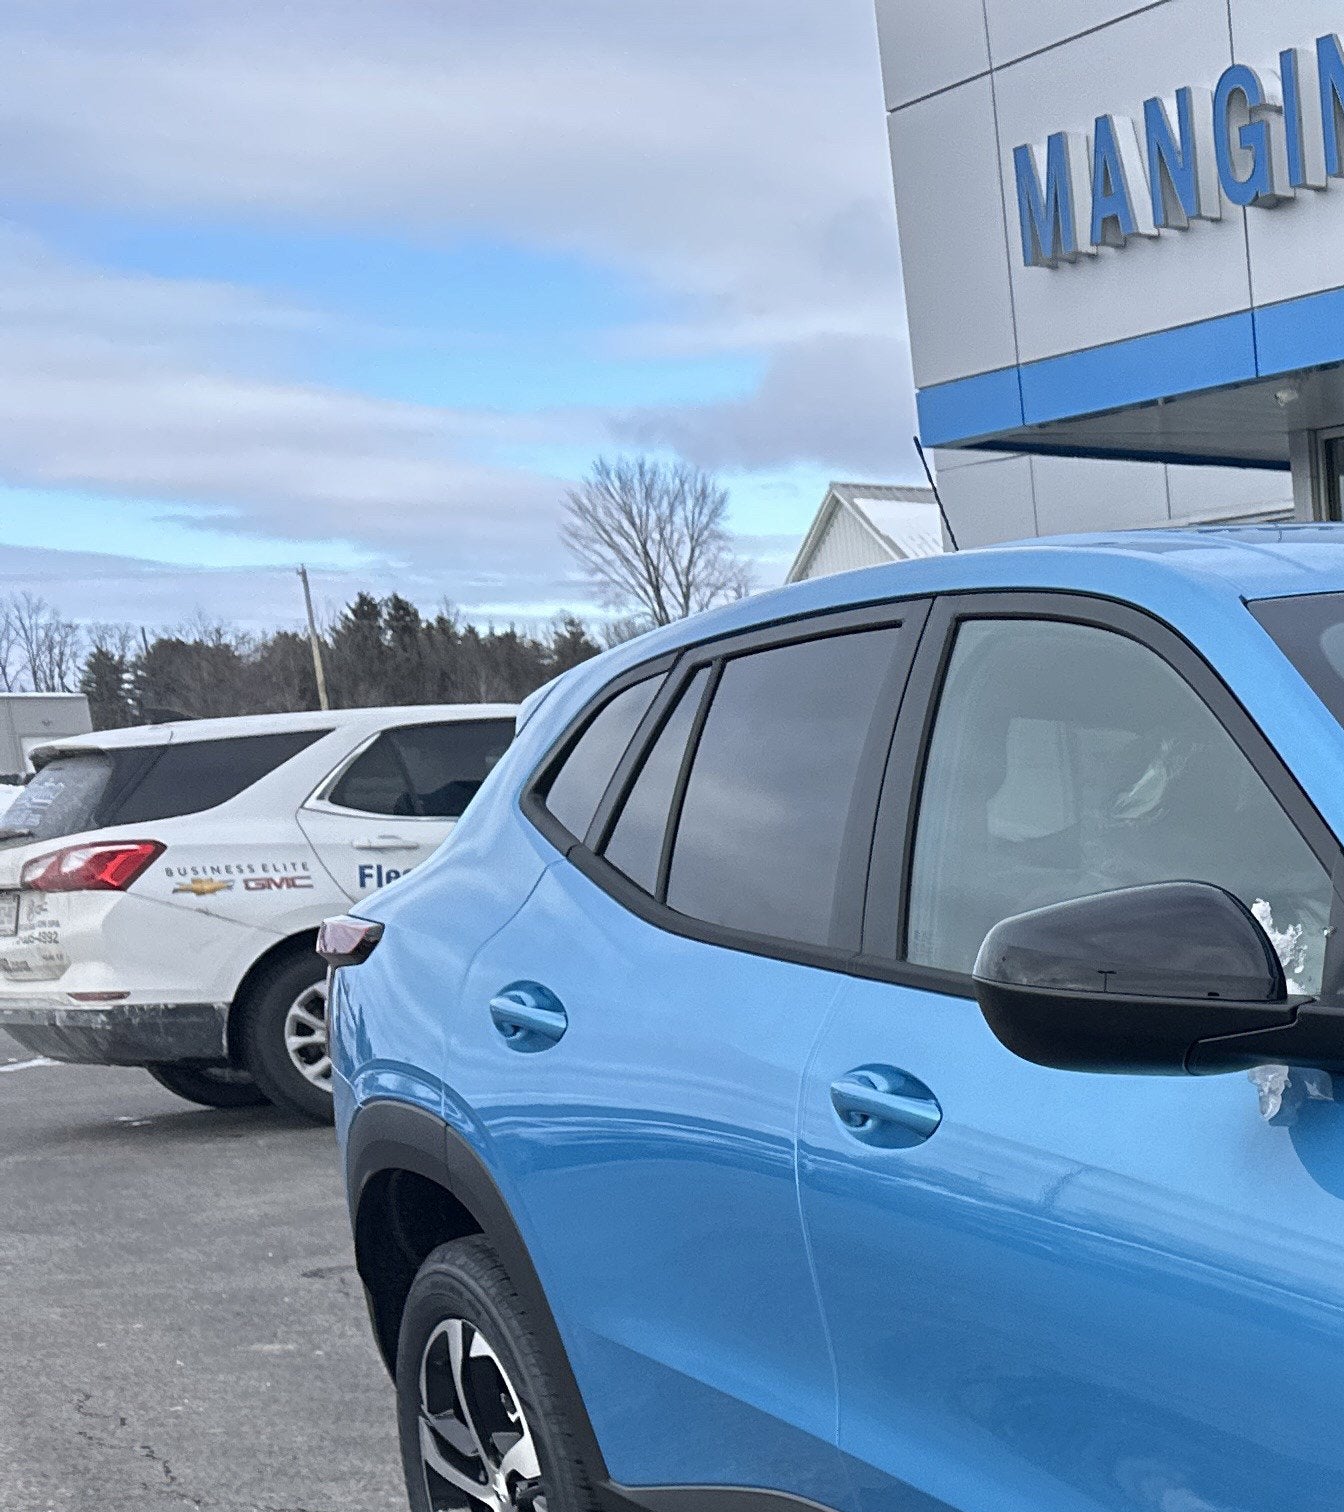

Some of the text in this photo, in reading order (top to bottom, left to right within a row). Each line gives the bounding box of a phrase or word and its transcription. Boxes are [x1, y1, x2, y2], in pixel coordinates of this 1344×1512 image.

[165, 861, 309, 877] BUSINESS ELITE
[243, 875, 314, 891] GMC
